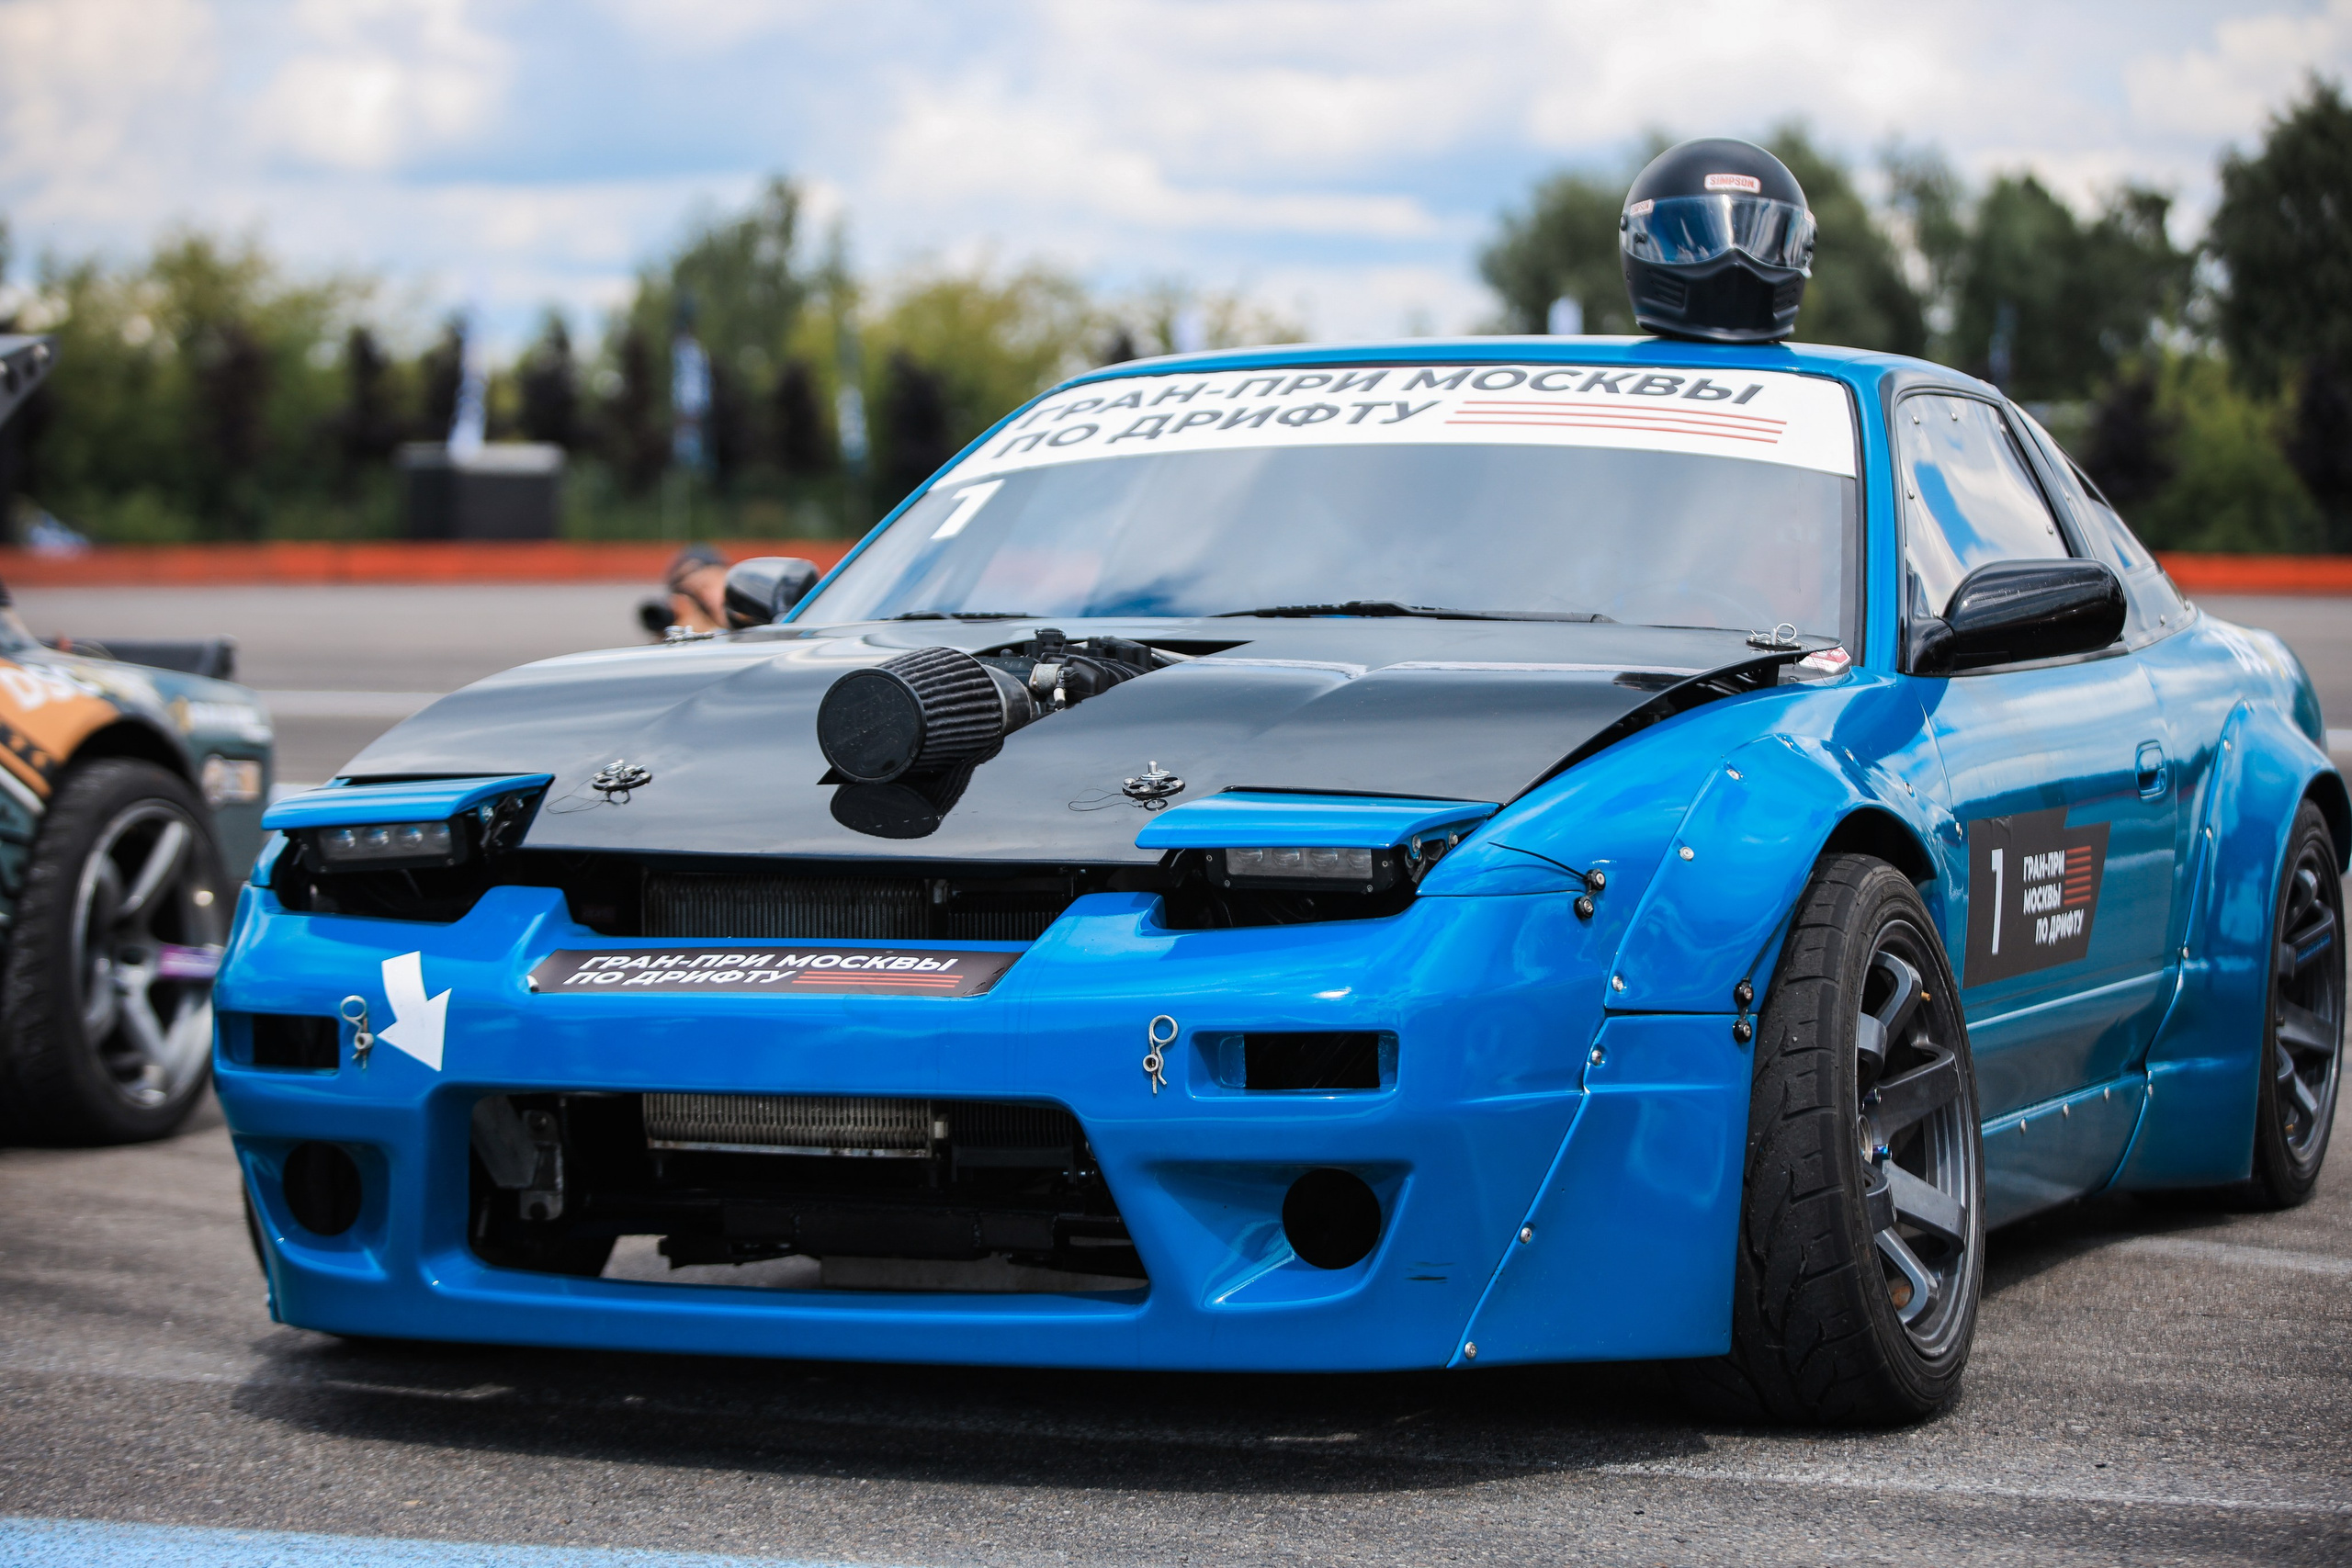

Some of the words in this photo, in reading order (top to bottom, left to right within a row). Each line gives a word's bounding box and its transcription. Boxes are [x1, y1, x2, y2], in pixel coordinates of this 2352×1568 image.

[1709, 175, 1756, 188] SIMPSON
[1014, 369, 1391, 430] ГРАН-ПРИ
[1399, 367, 1764, 404] МОСКВЫ
[990, 423, 1100, 458] ПО
[1103, 400, 1443, 445] ДРИФТУ
[929, 479, 1006, 542] 1
[2023, 850, 2065, 883] ГРАН-ПРИ
[1991, 848, 2004, 955] 1
[2023, 882, 2062, 915] МОСКВЫ
[2035, 917, 2049, 945] ПО
[2048, 908, 2085, 946] ДРИФТУ
[562, 971, 626, 986] ПО
[620, 969, 797, 986] ДРИФТУ
[578, 953, 775, 970] ГРАН-ПРИ
[775, 953, 959, 972] МОСКВЫ
